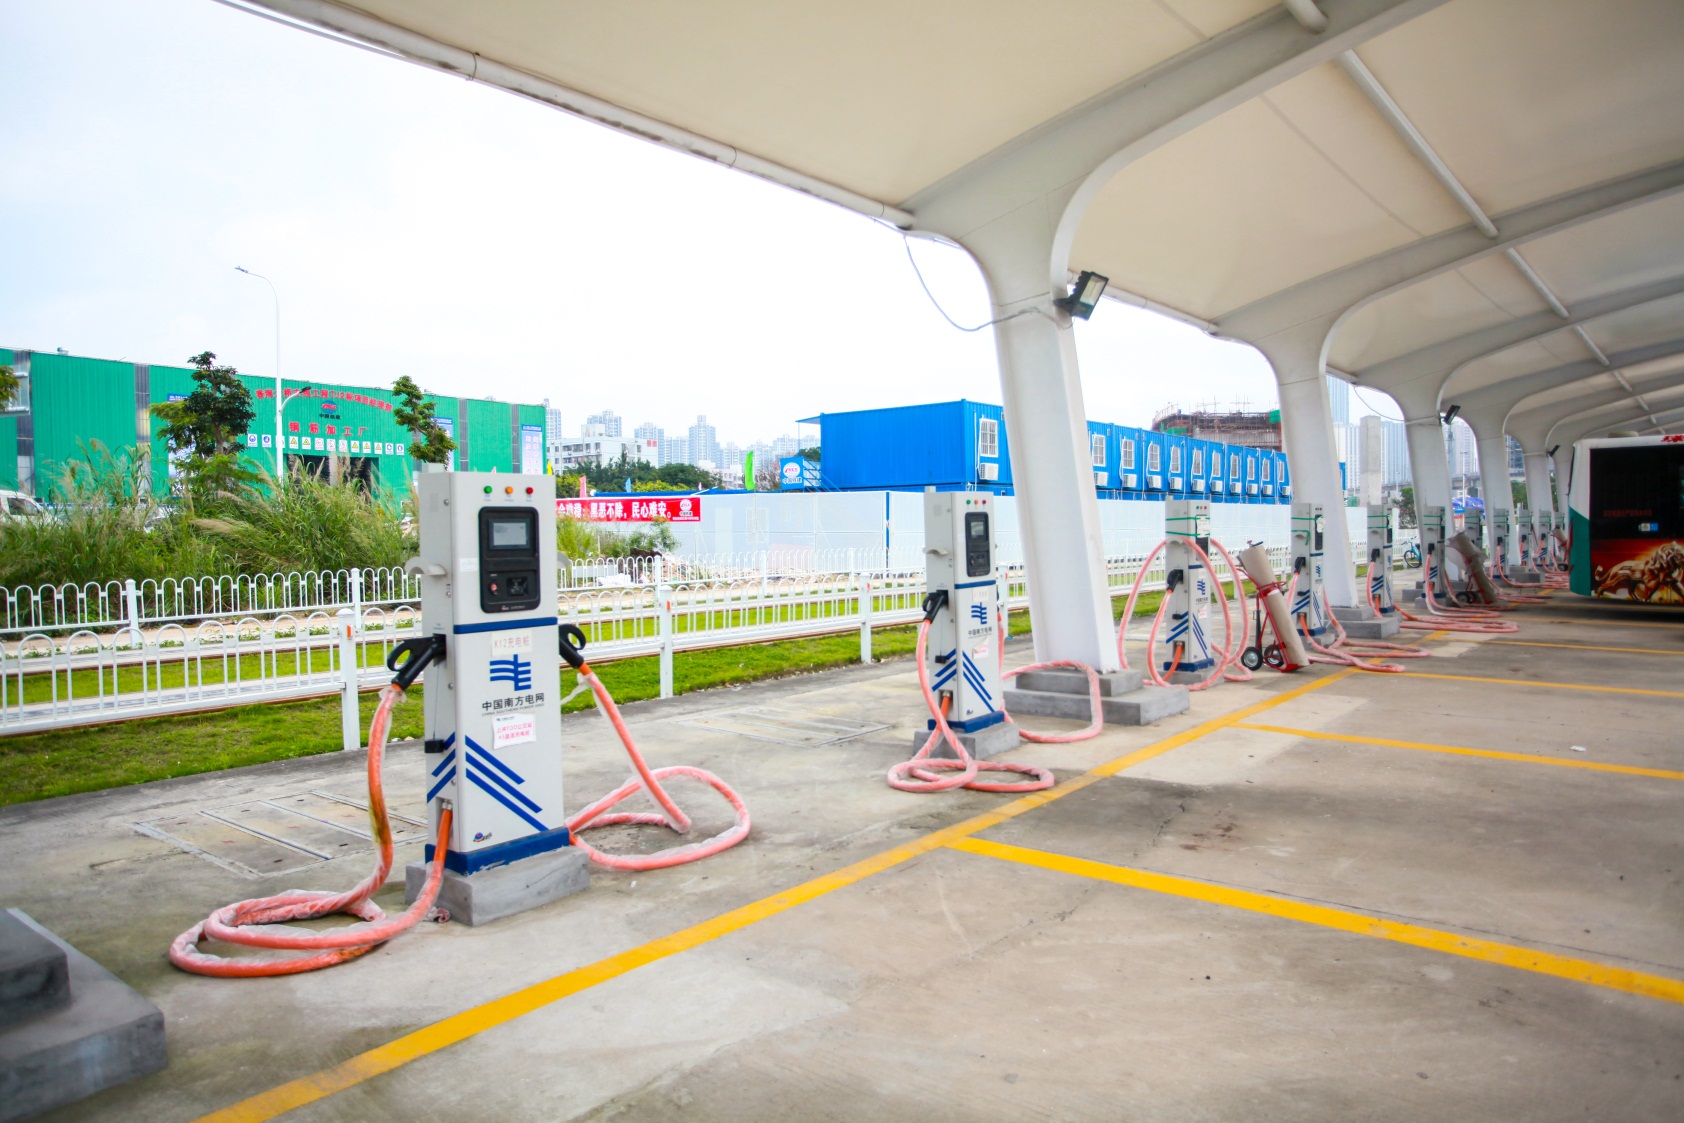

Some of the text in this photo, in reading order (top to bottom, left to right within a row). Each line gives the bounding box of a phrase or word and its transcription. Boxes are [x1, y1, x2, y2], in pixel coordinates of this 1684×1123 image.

[289, 421, 368, 436] 钢筋加工厂
[482, 693, 545, 711] 中国南方电网
